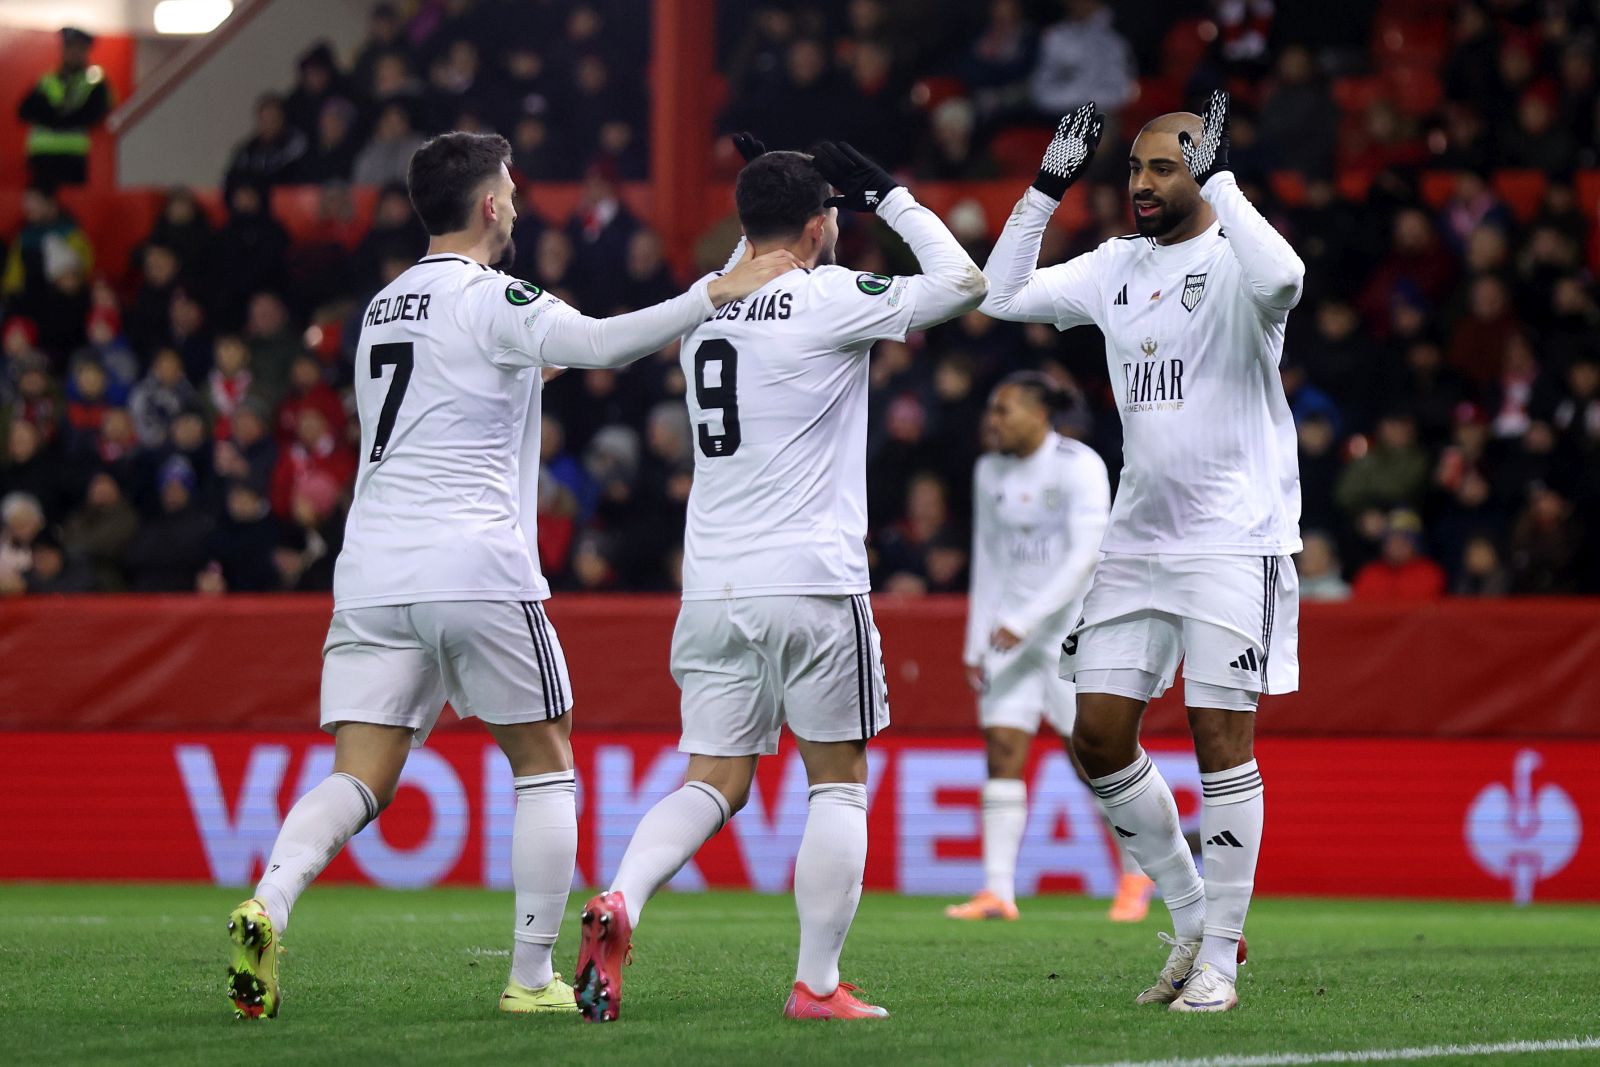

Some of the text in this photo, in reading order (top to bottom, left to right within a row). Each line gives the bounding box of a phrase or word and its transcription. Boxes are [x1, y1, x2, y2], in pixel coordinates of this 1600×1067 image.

[1186, 275, 1206, 285] NOAH
[364, 293, 431, 328] HELDER
[744, 288, 793, 322] AIÁS
[694, 338, 742, 458] 9
[1123, 358, 1184, 404] TAKAR
[370, 341, 415, 463] 7
[1156, 401, 1184, 411] WINE
[271, 864, 281, 873] 7
[526, 914, 535, 926] 7
